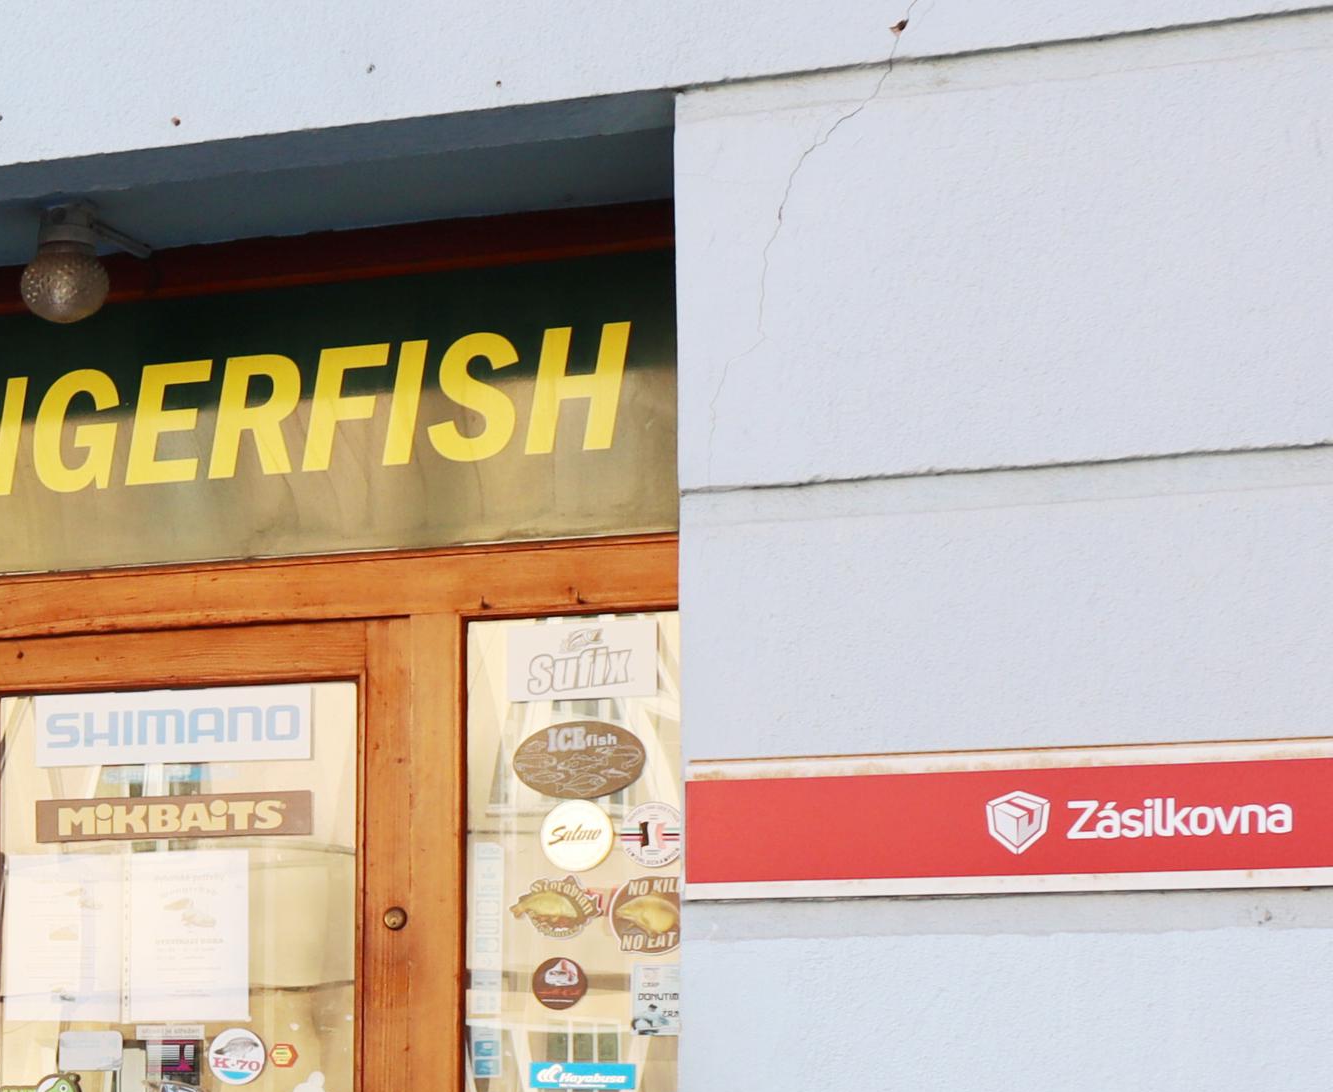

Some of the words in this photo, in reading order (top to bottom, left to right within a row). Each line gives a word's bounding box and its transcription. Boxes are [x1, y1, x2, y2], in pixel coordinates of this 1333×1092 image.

[527, 646, 633, 695] Sufix
[46, 704, 301, 749] SHIMANO
[1066, 797, 1293, 840] Zásilkovna
[628, 880, 649, 896] NO
[653, 878, 678, 893] KIL
[622, 934, 643, 950] NO
[559, 1073, 626, 1084] Hayabusa
